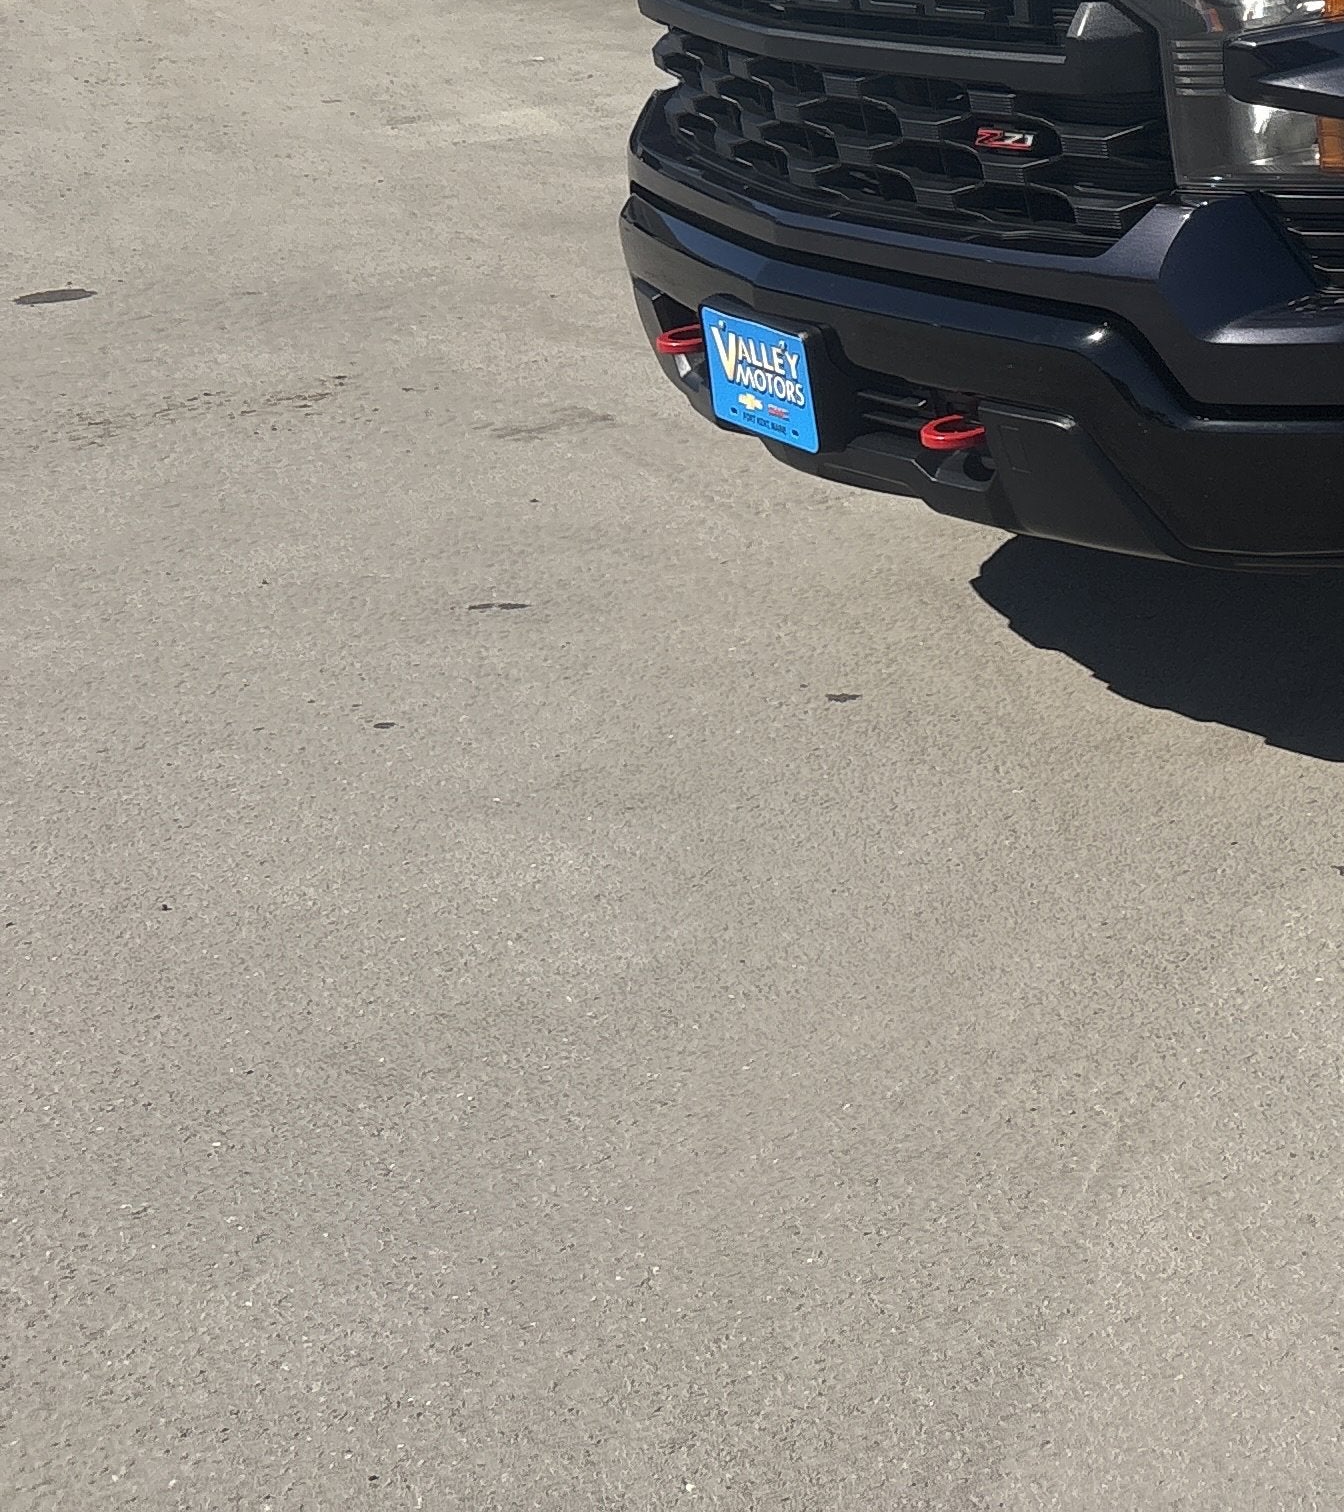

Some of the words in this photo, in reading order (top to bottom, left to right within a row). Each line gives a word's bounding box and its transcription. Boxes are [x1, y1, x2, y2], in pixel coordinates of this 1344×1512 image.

[975, 127, 1035, 151] Z71
[709, 325, 799, 381] VALLEY
[735, 363, 806, 408] MOTORS
